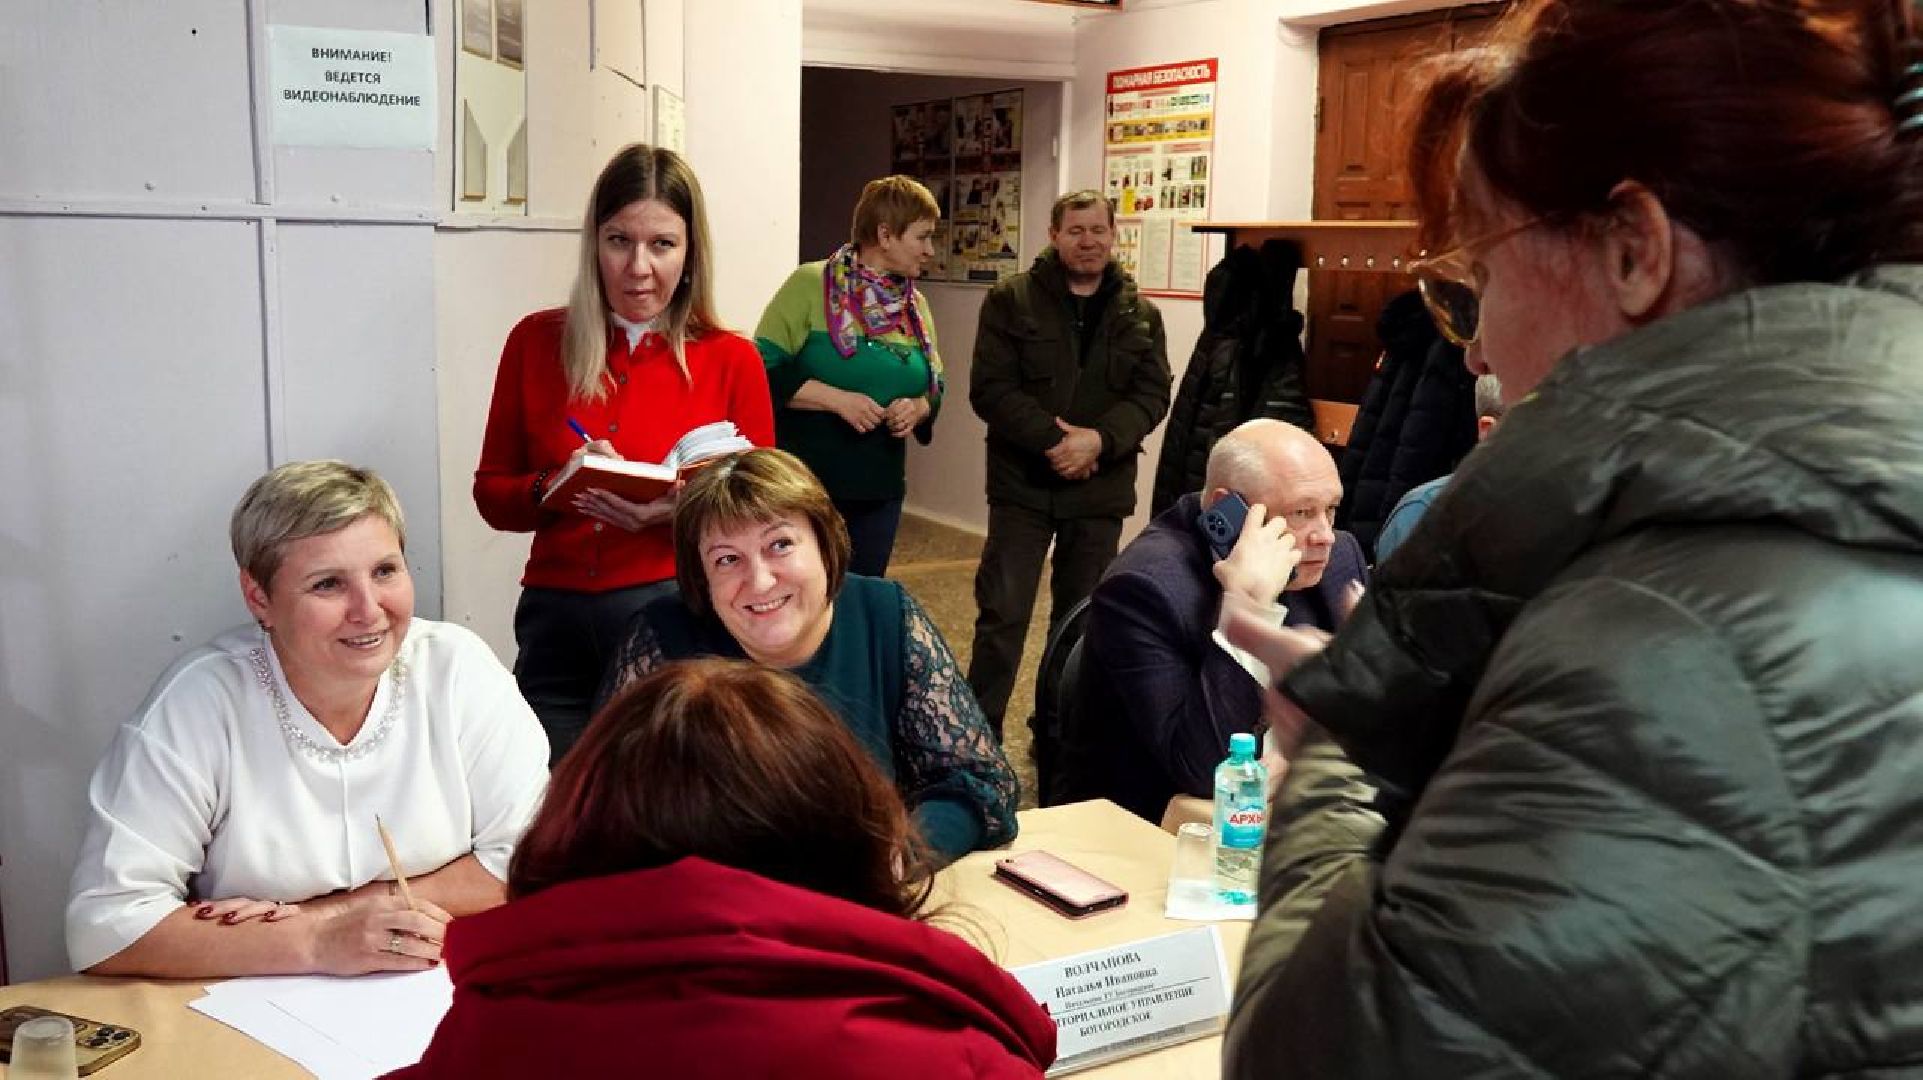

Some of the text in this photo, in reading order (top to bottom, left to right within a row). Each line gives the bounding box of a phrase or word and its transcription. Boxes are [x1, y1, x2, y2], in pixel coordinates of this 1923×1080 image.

[311, 47, 392, 63] ВНИМАНИЕ!
[325, 70, 381, 84] ВЕДЕТСЯ
[1153, 63, 1210, 84] БЕЗОПАСНОСТЬ
[283, 88, 421, 107] ВИДЕОНАБЛЮДЕНИЕ
[1229, 813, 1265, 825] АРХЫ
[1064, 952, 1141, 978] ВОЛЧАНОВА
[1055, 967, 1158, 999] Наталья Ивановна
[1079, 1011, 1151, 1037] БОГОРОДСКОЕ
